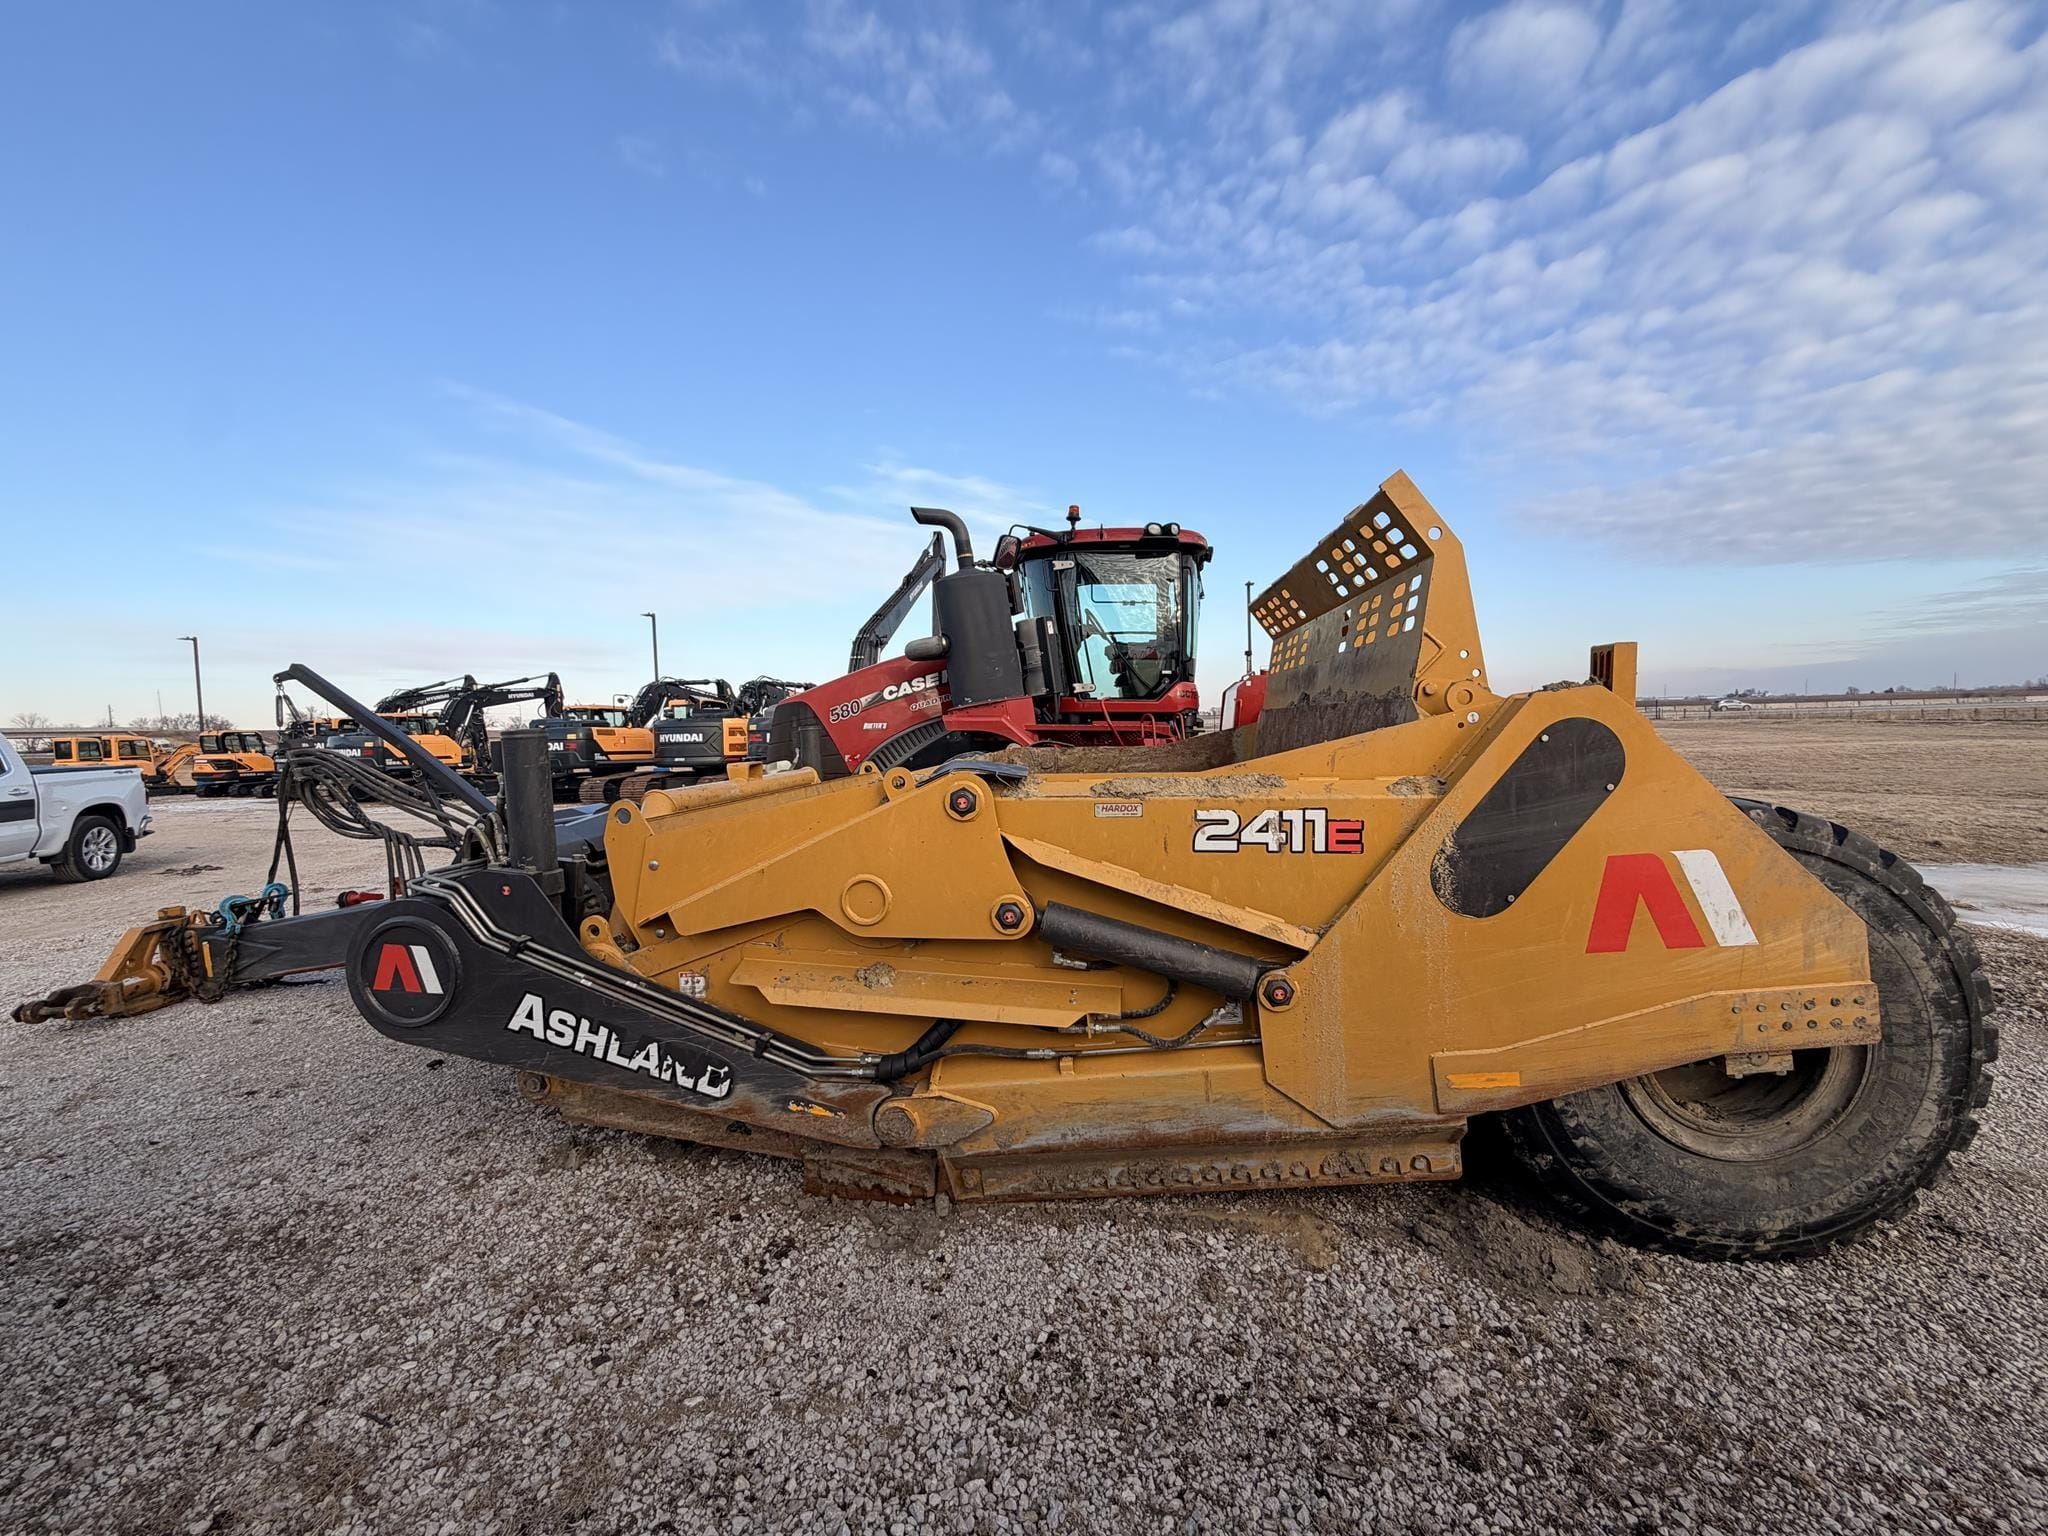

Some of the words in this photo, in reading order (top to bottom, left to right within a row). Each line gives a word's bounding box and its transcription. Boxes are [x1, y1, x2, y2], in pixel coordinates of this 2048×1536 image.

[882, 672, 939, 701] CASE
[830, 698, 862, 724] 580
[659, 732, 704, 743] HYUNDAI
[1101, 804, 1139, 813] HARDOX
[1192, 807, 1365, 855] 2411E
